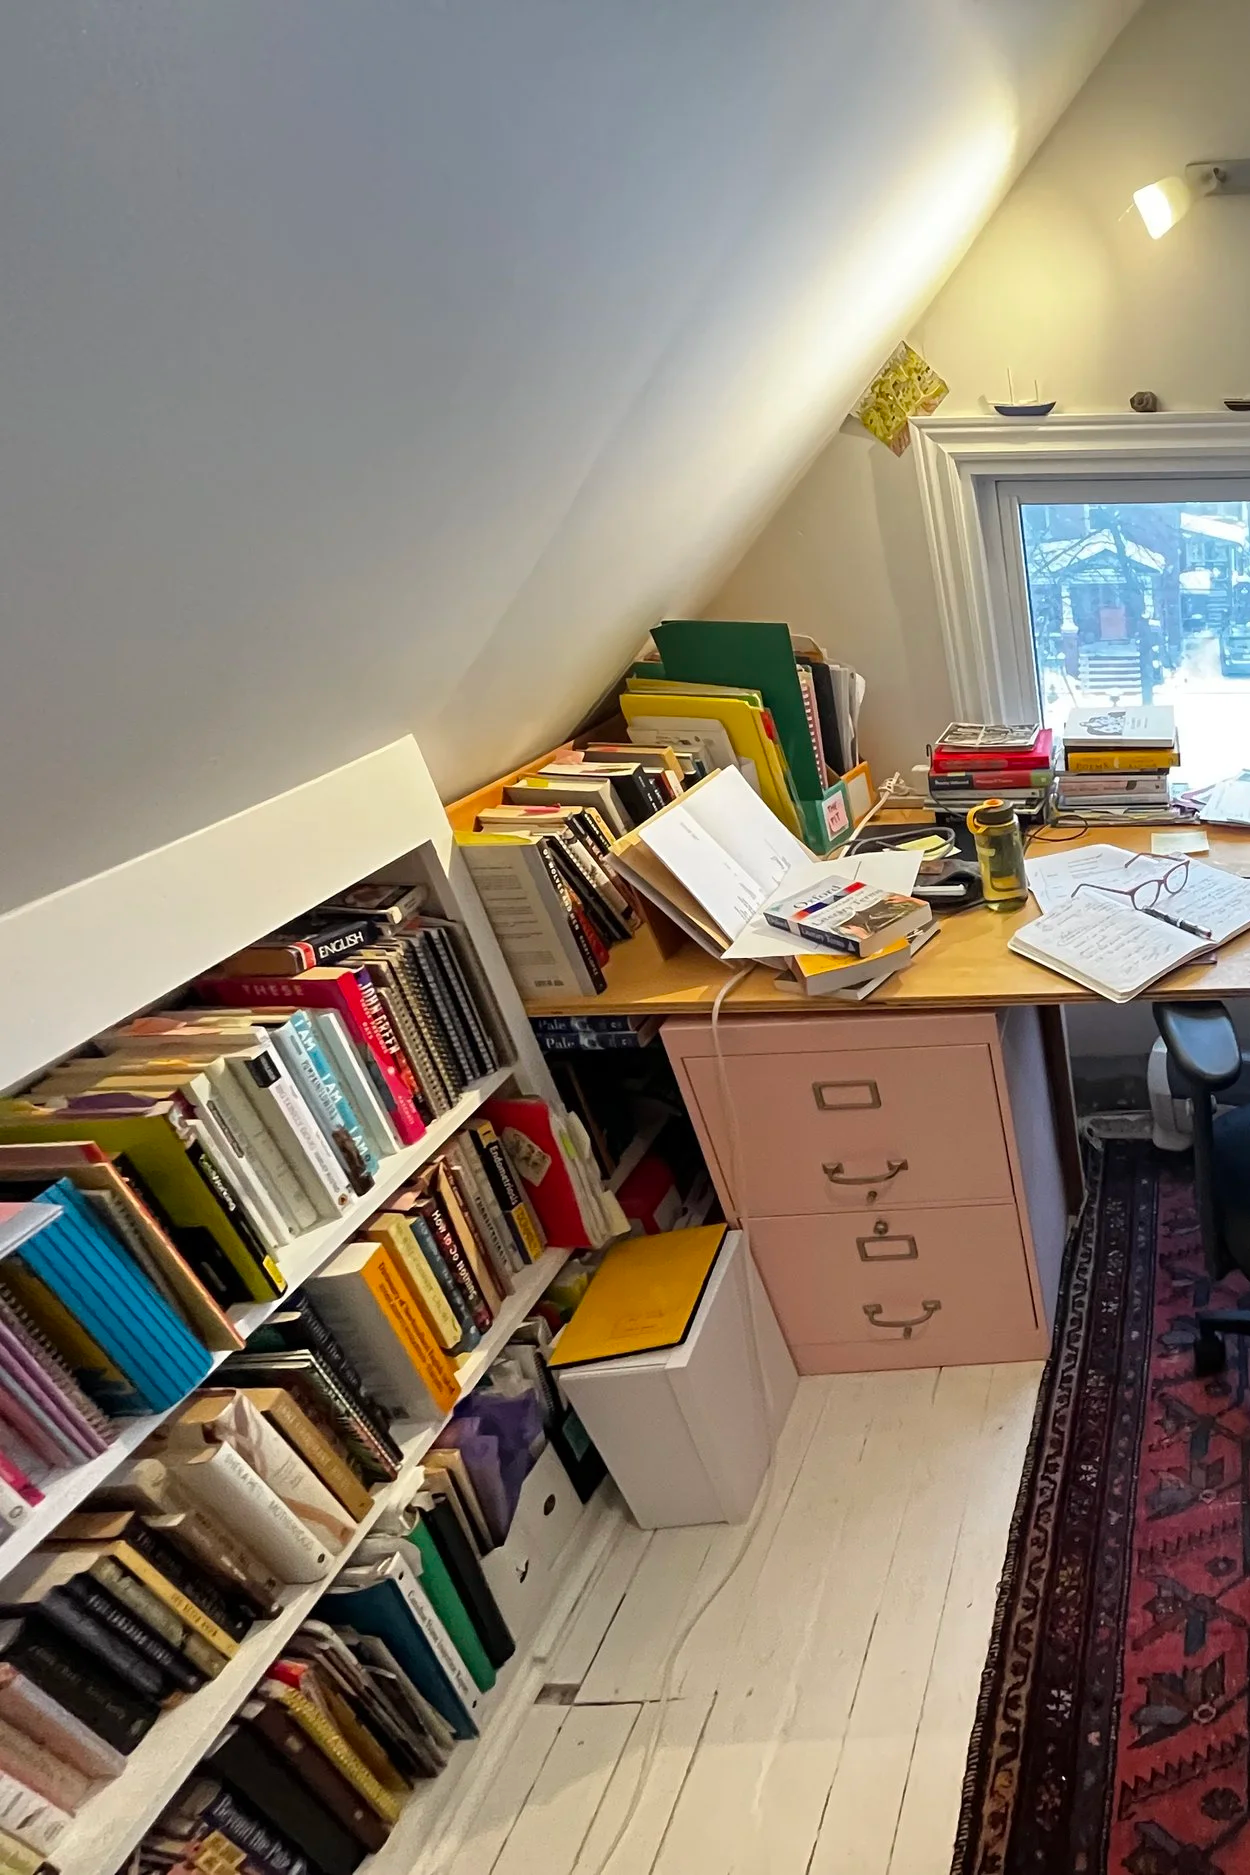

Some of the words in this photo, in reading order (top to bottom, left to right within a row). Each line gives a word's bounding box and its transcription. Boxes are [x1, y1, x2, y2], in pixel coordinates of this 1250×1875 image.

[543, 848, 554, 864] OF
[548, 862, 566, 897] WOLVES
[561, 895, 572, 913] AND
[793, 885, 843, 909] Oxford
[569, 912, 580, 931] MEN
[319, 931, 365, 959] ENGLISH
[241, 983, 305, 997] THESE
[358, 981, 385, 1016] JOHN
[372, 1011, 401, 1056] GREEN
[299, 1027, 315, 1051] AM
[546, 1037, 575, 1048] Pale
[327, 1081, 342, 1103] AM
[354, 1133, 368, 1156] AM
[488, 1143, 519, 1206] Endometriosis
[430, 1208, 449, 1234] How
[454, 1260, 477, 1301] Nothing
[212, 1793, 257, 1840] Beyond
[262, 1839, 297, 1874] Pale
